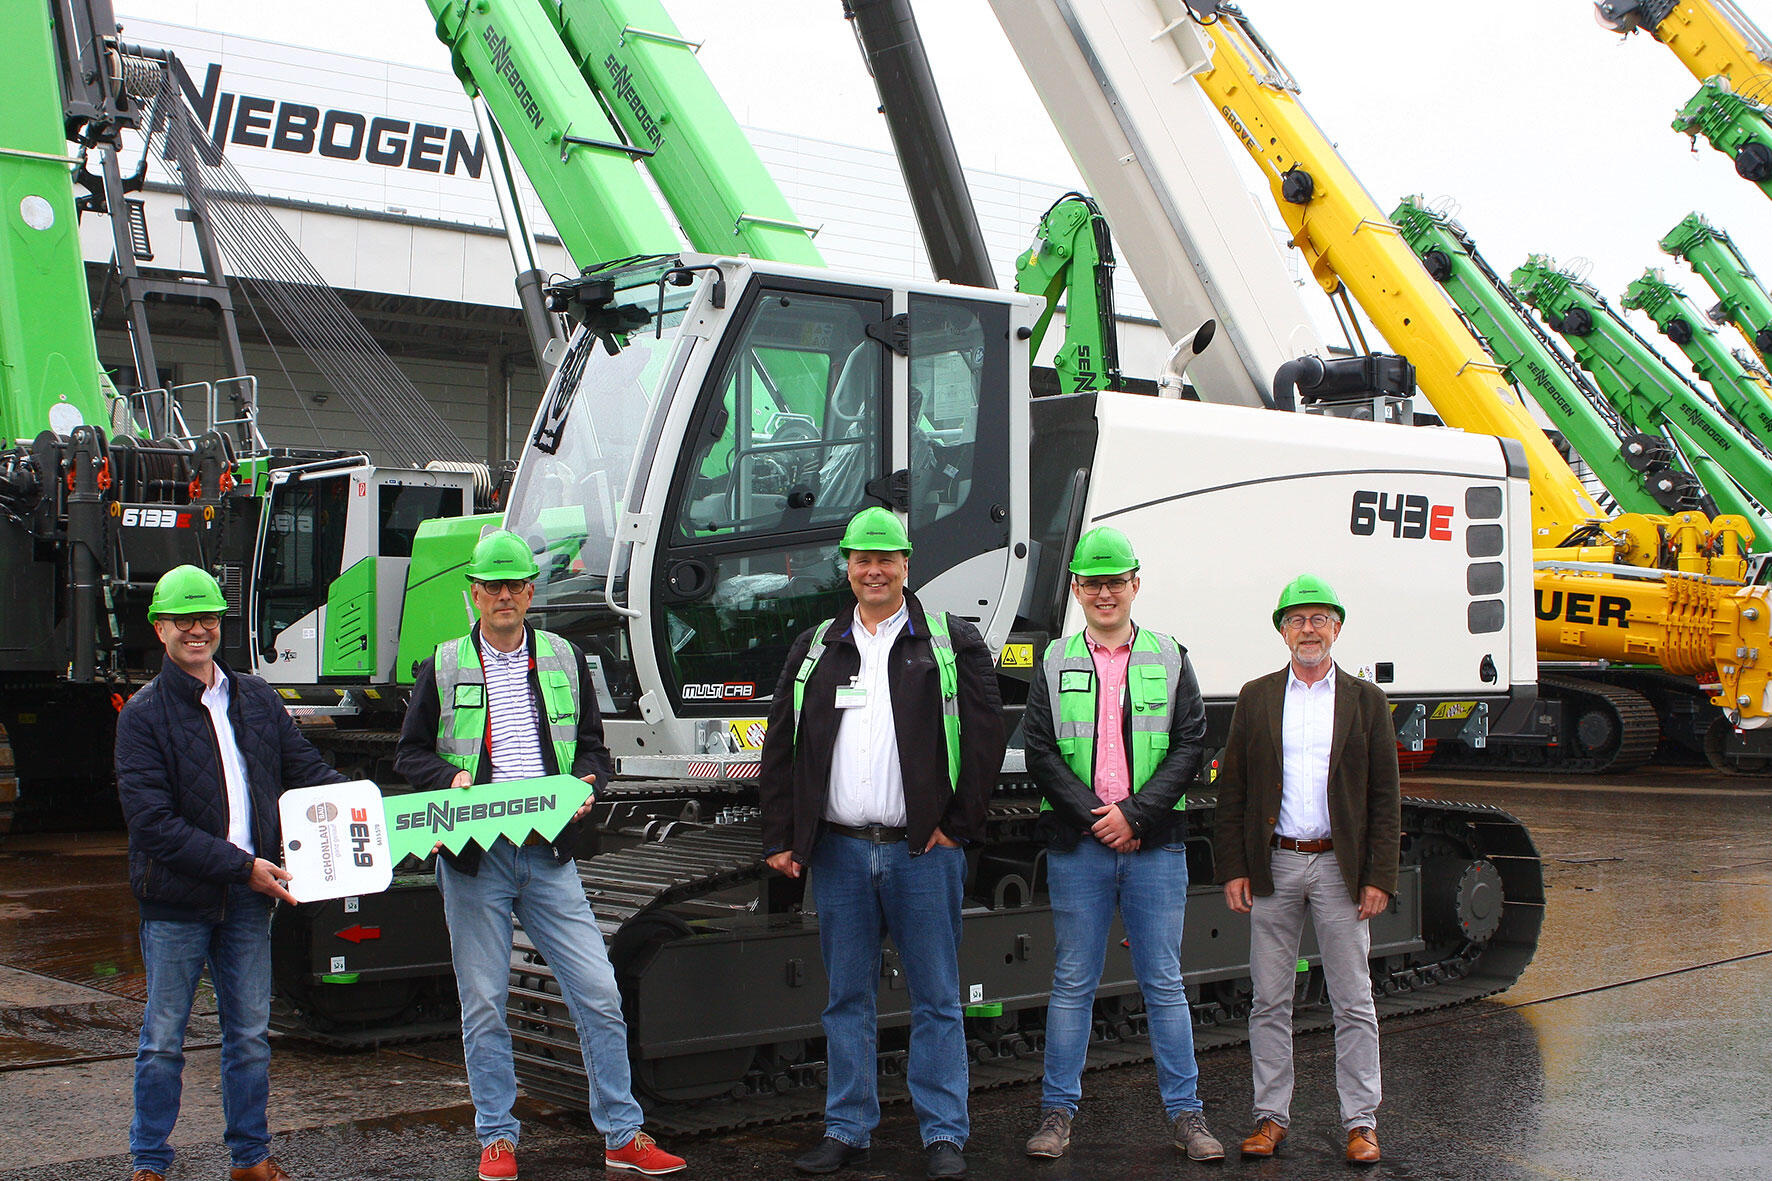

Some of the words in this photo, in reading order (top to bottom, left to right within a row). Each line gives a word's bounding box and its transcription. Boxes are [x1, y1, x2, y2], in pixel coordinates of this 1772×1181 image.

[482, 24, 544, 130] SENNEBOGEN
[603, 53, 665, 147] SENNEBOGEN
[1221, 105, 1256, 151] GROVE
[1526, 361, 1575, 417] SENNEBOGEN
[1680, 403, 1732, 451] SENNEBOGEN
[121, 508, 193, 528] 6133E
[1350, 490, 1455, 542] 643E
[724, 683, 754, 698] CAB
[350, 807, 374, 868] 643E
[395, 794, 557, 834] SENNEBOGEN
